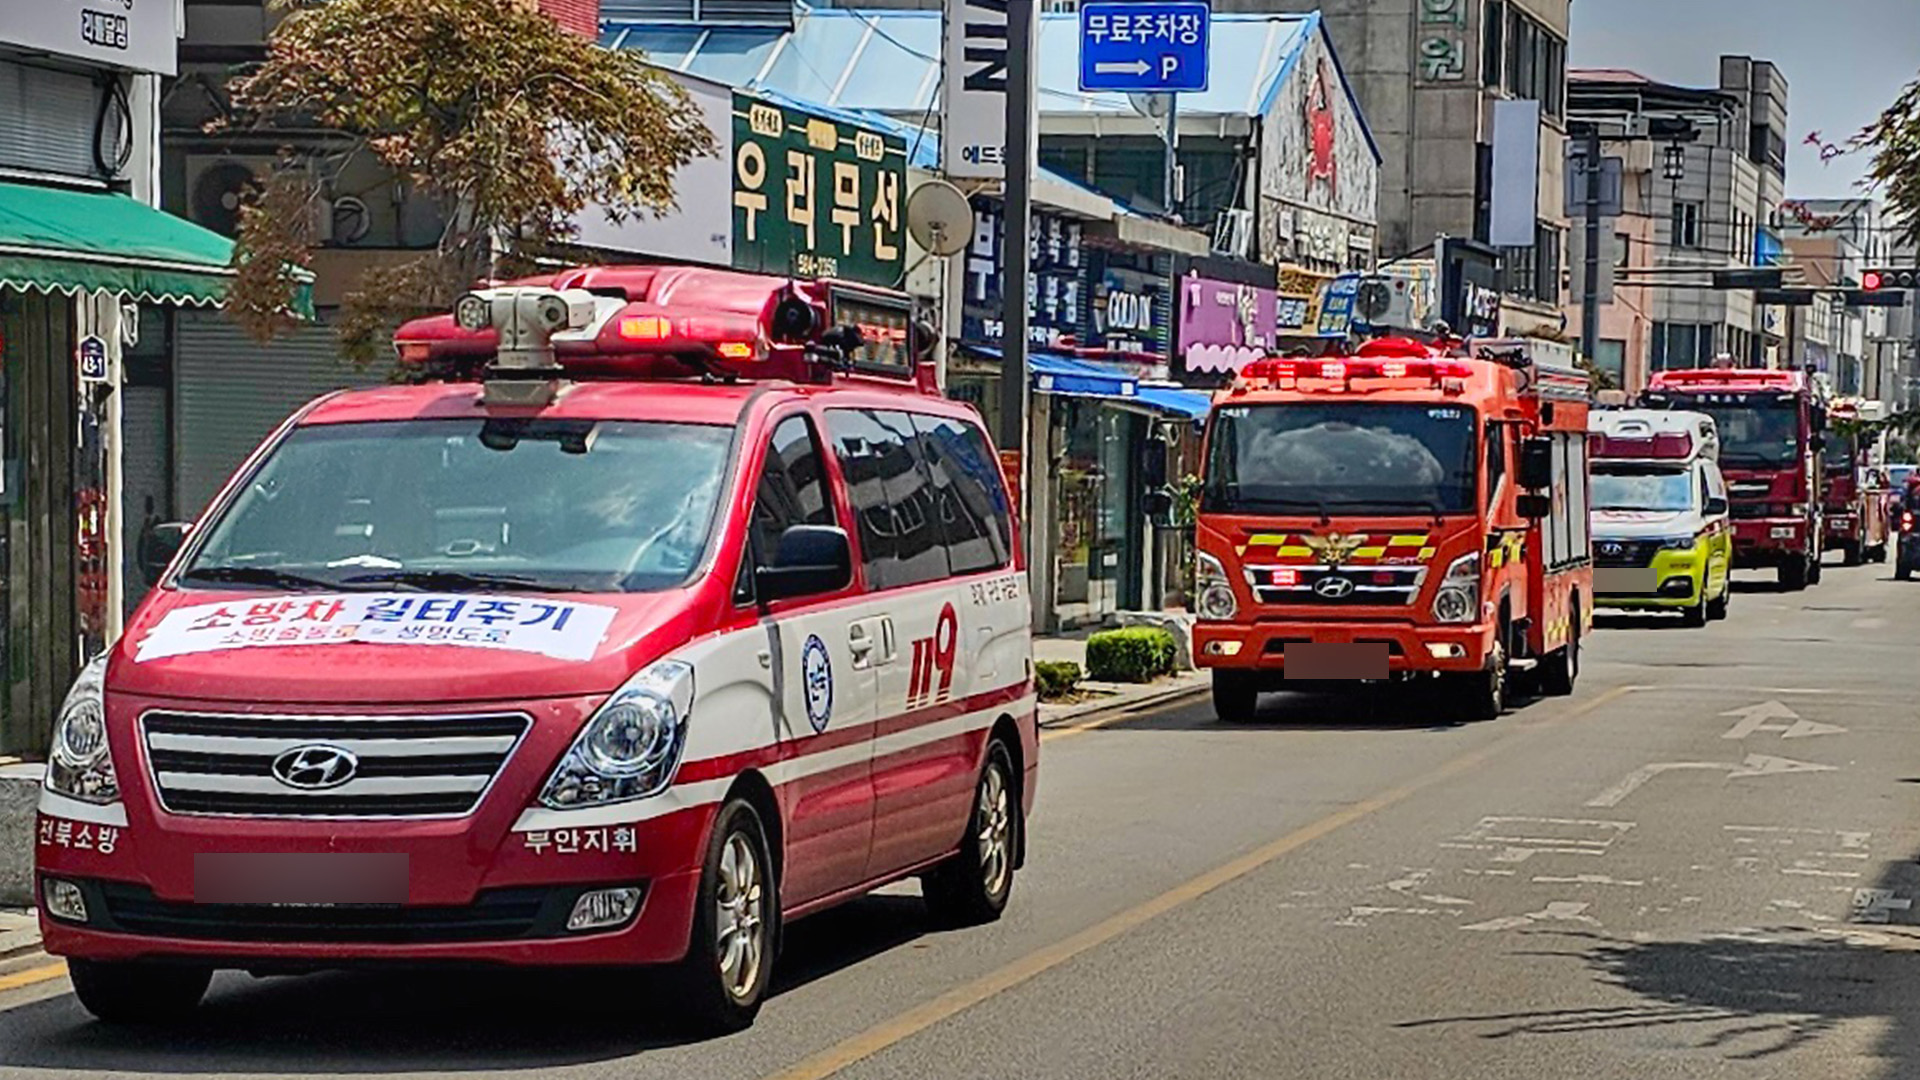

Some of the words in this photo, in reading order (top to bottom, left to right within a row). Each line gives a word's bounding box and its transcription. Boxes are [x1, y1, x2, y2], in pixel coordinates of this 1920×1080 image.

[1086, 13, 1200, 45] 무료주차장
[1161, 56, 1178, 80] P
[961, 145, 1006, 166] 에드
[734, 140, 898, 261] 우리무선
[186, 597, 346, 632] 소방차
[361, 597, 575, 632] 길터주기
[906, 602, 958, 710] 119
[39, 819, 119, 854] 전북소방
[524, 827, 638, 854] 부안지휘
